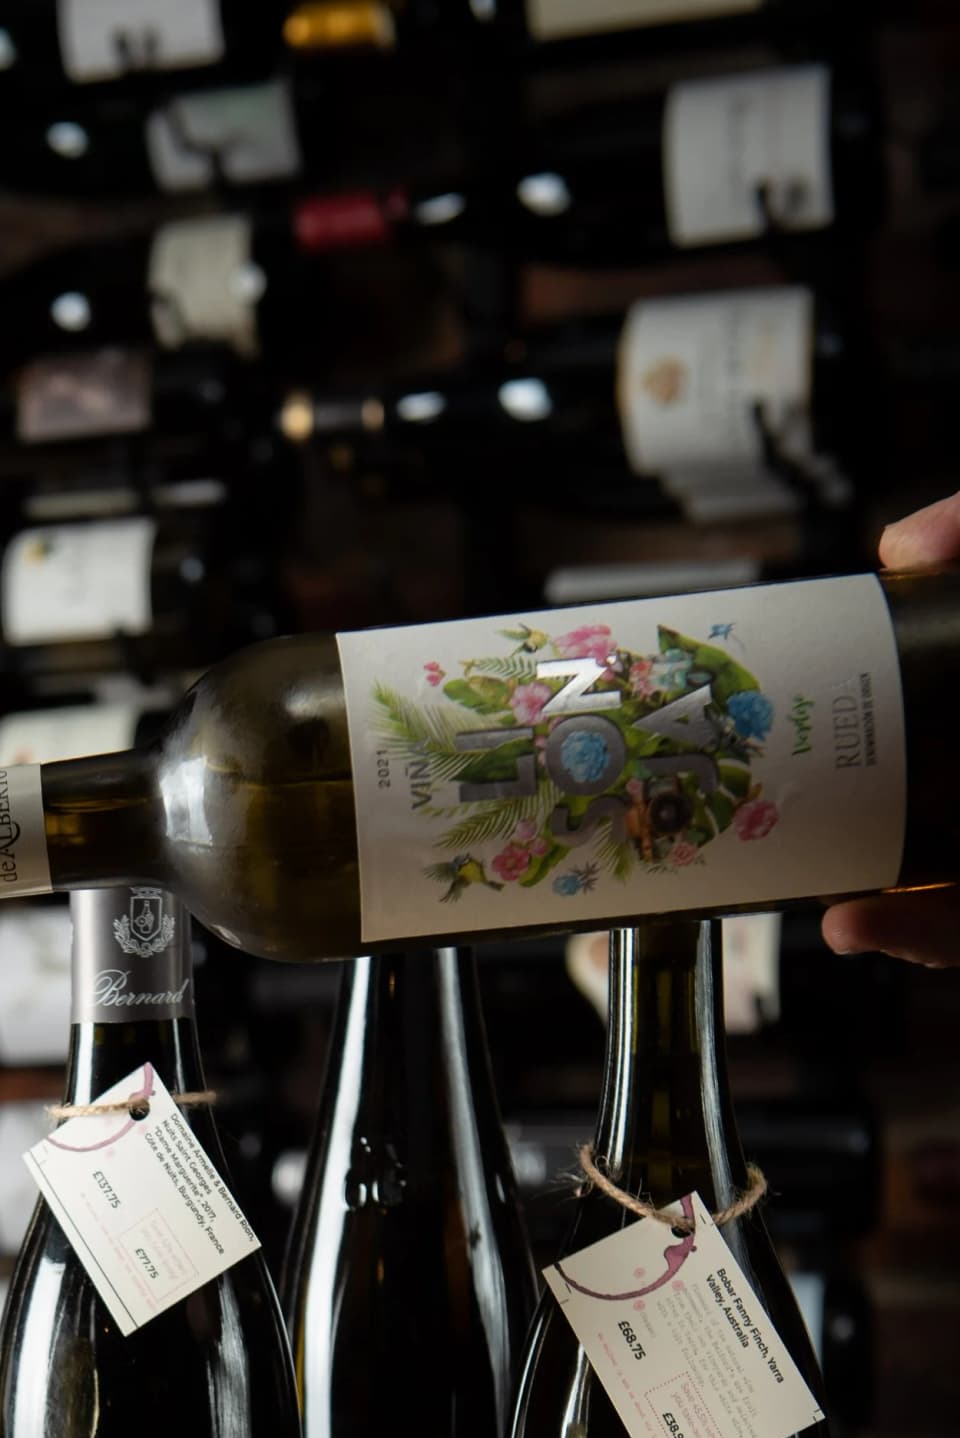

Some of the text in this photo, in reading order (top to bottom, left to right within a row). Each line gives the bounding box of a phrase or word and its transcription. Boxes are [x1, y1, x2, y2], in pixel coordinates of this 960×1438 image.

[835, 678, 860, 770] RUEDA
[377, 749, 390, 789] 2021
[405, 739, 433, 809] VIÑA
[89, 968, 189, 1007] Bernard
[92, 1169, 121, 1209] £137.75
[162, 1119, 212, 1195] Nuits Saint Georges
[170, 1113, 195, 1148] Domaine
[193, 1148, 215, 1179] Armelle
[218, 1186, 241, 1219] Bernard
[156, 1151, 165, 1162] de
[204, 1225, 226, 1254] France
[134, 1246, 159, 1279] £77.75
[617, 1319, 646, 1361] £68.75
[704, 1274, 726, 1306] Valley,
[722, 1305, 751, 1348] Australia
[716, 1268, 785, 1383] Bobar Fanny Finch, Yarra
